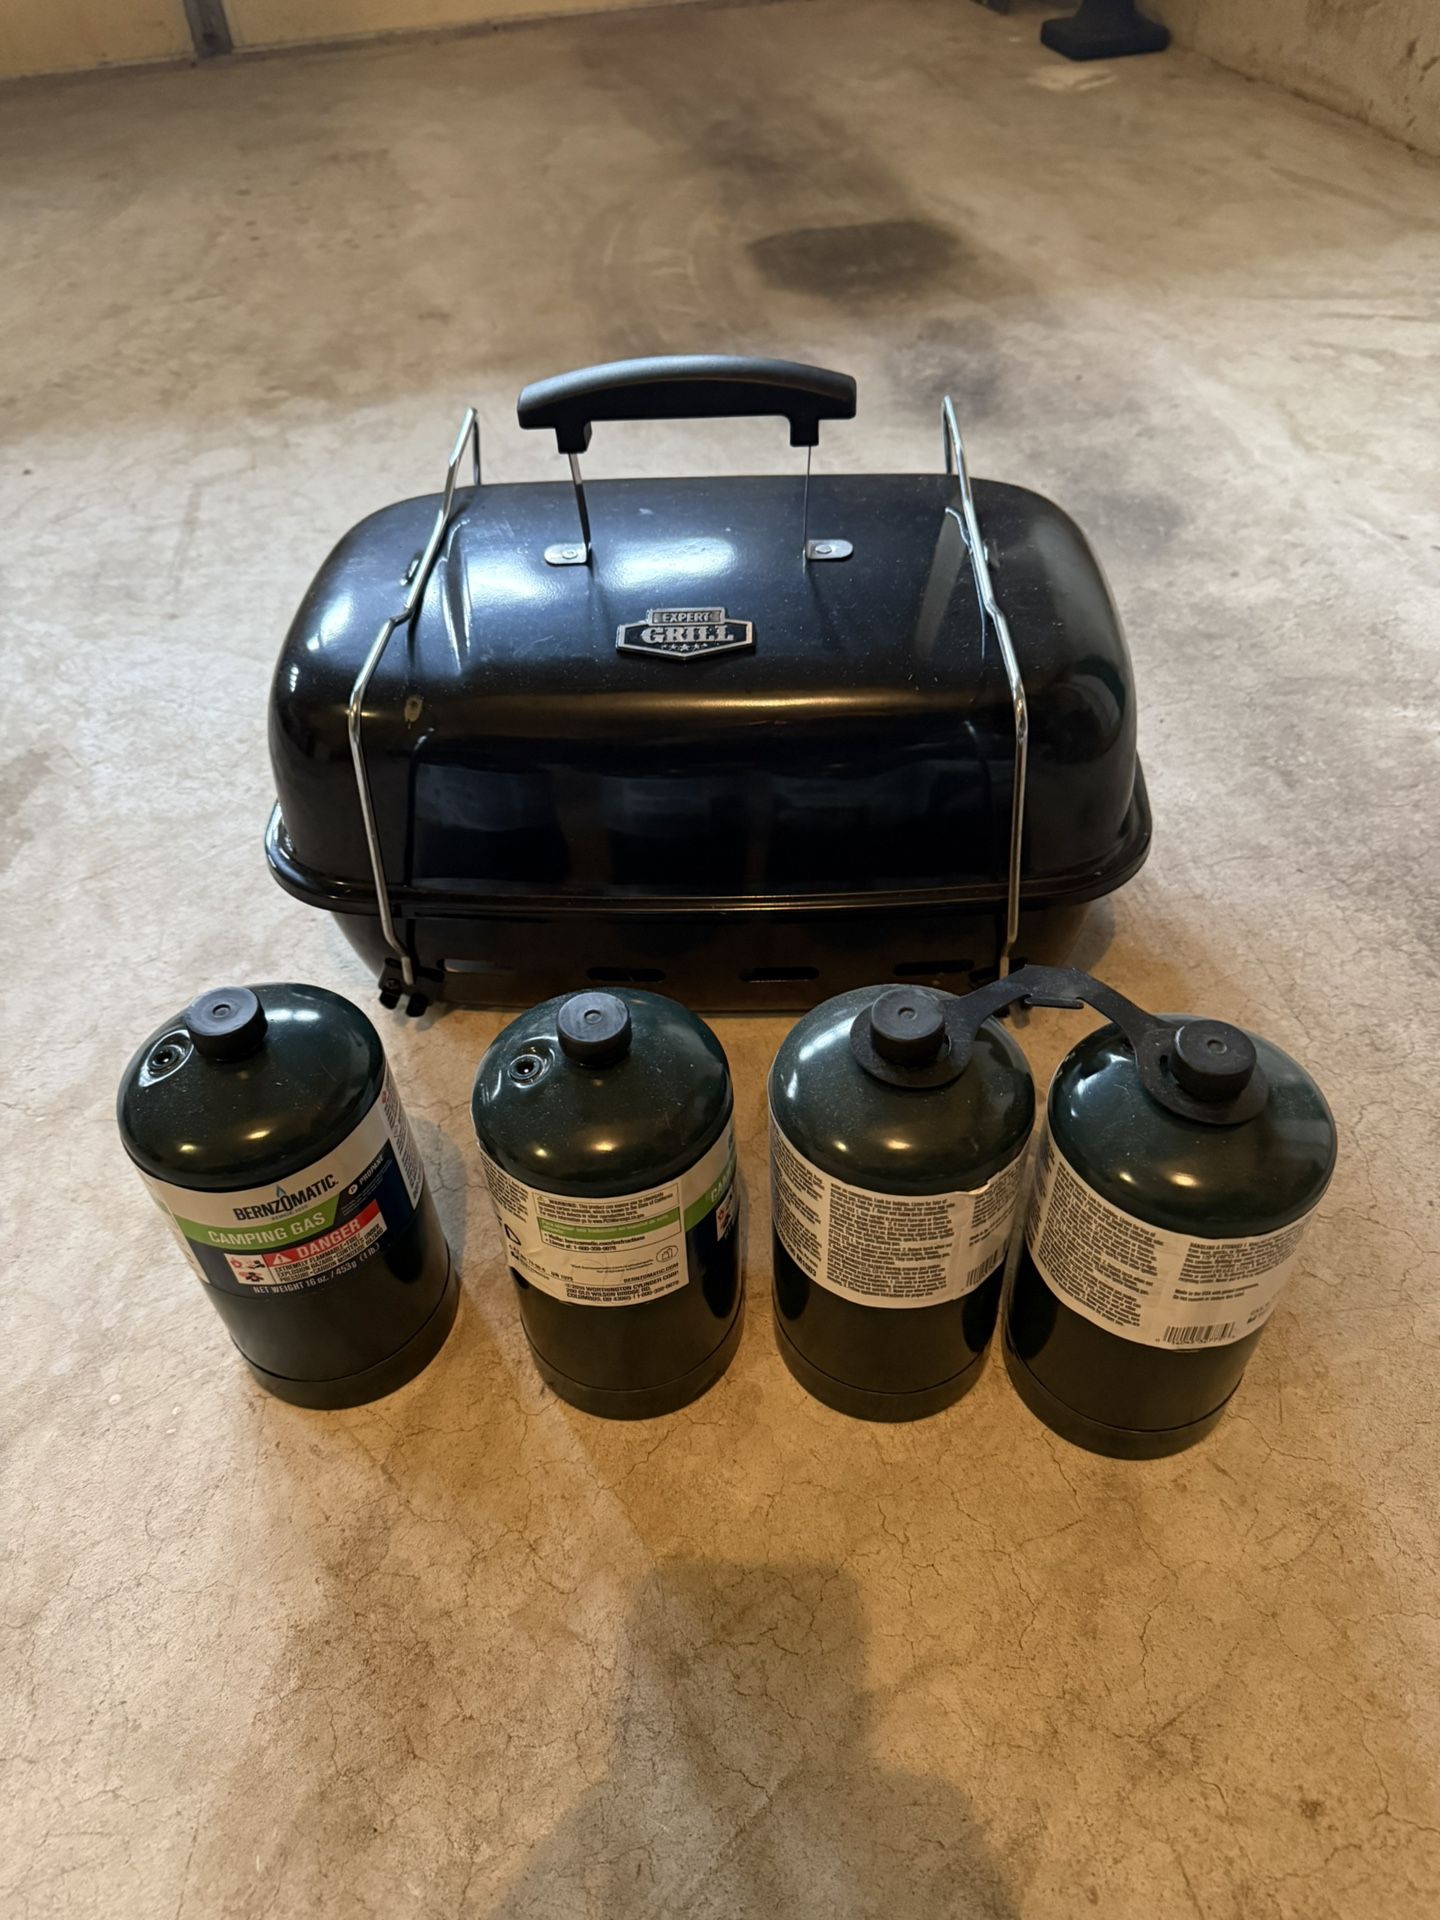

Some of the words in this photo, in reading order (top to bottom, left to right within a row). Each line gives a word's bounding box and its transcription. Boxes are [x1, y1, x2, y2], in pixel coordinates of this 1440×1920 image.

[662, 611, 711, 623] EXPERT
[641, 626, 734, 644] GRILL
[233, 1174, 336, 1221] BERNZOMATIC
[207, 1225, 288, 1246] CAMPING
[290, 1212, 326, 1236] GAS
[296, 1218, 361, 1258] DANGER
[253, 1285, 270, 1294] NET
[271, 1281, 304, 1293] WEIGHT
